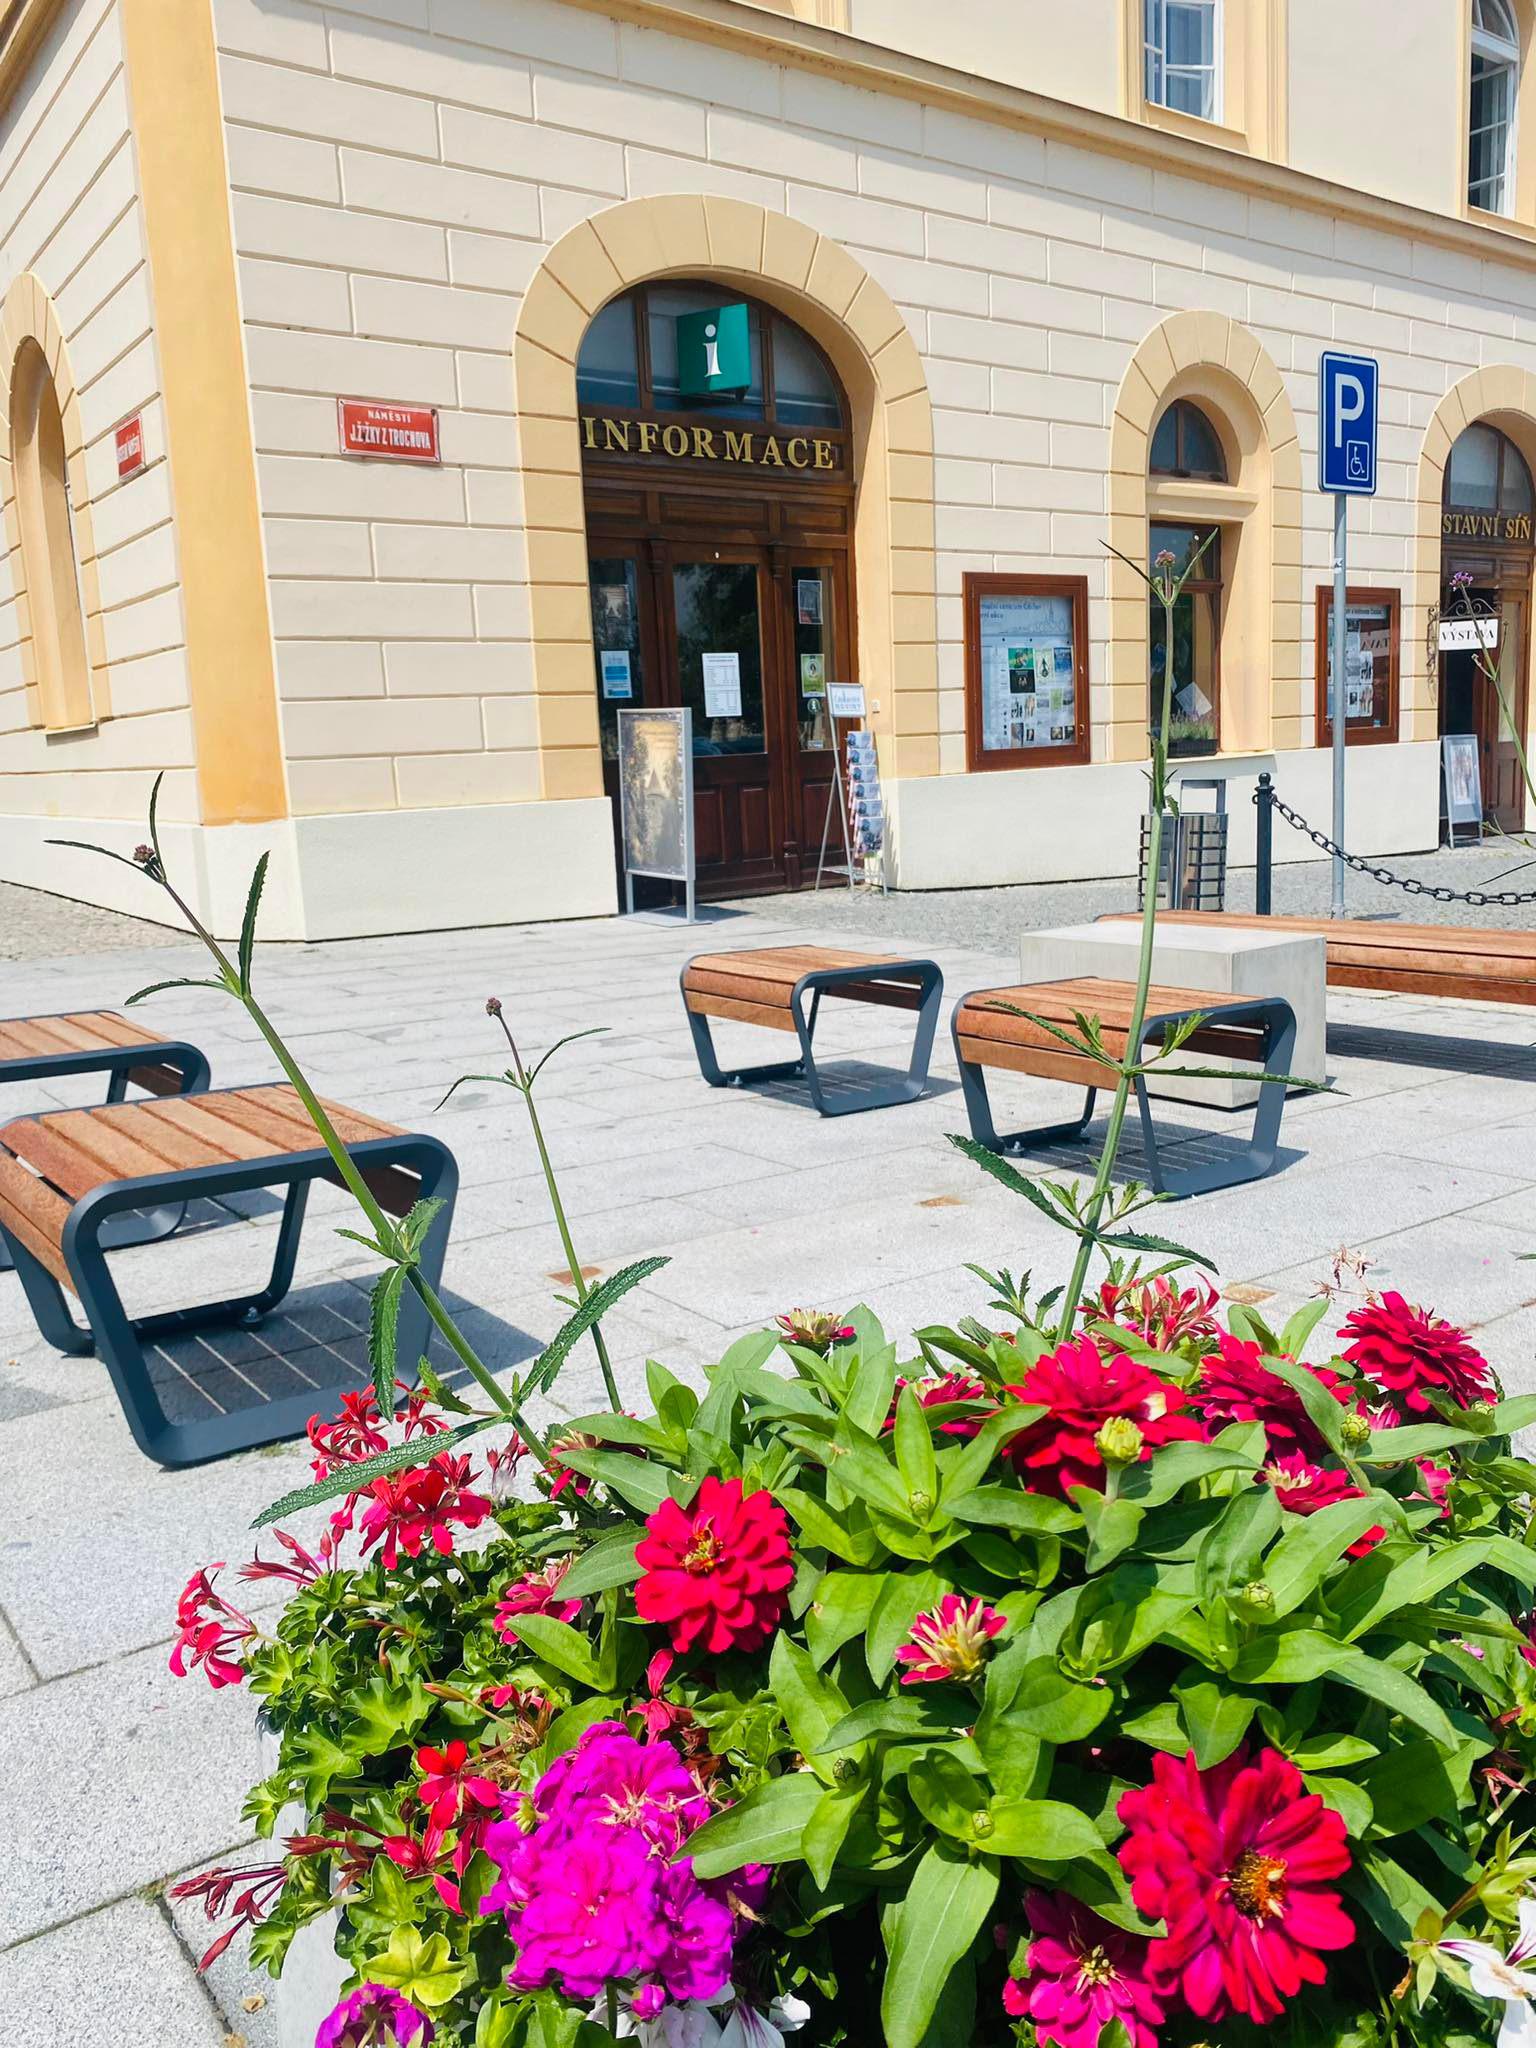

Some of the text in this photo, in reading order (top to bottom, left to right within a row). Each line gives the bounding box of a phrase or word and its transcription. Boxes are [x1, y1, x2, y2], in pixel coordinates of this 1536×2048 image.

[367, 409, 411, 423] NÁMĚSTÍ
[1334, 372, 1365, 448] P
[382, 428, 388, 445] Z
[388, 428, 431, 449] TROCNOVA
[581, 416, 834, 470] INFORMACE
[1505, 513, 1531, 540] SÍŇ
[1441, 627, 1494, 641] VÝSTAVA
